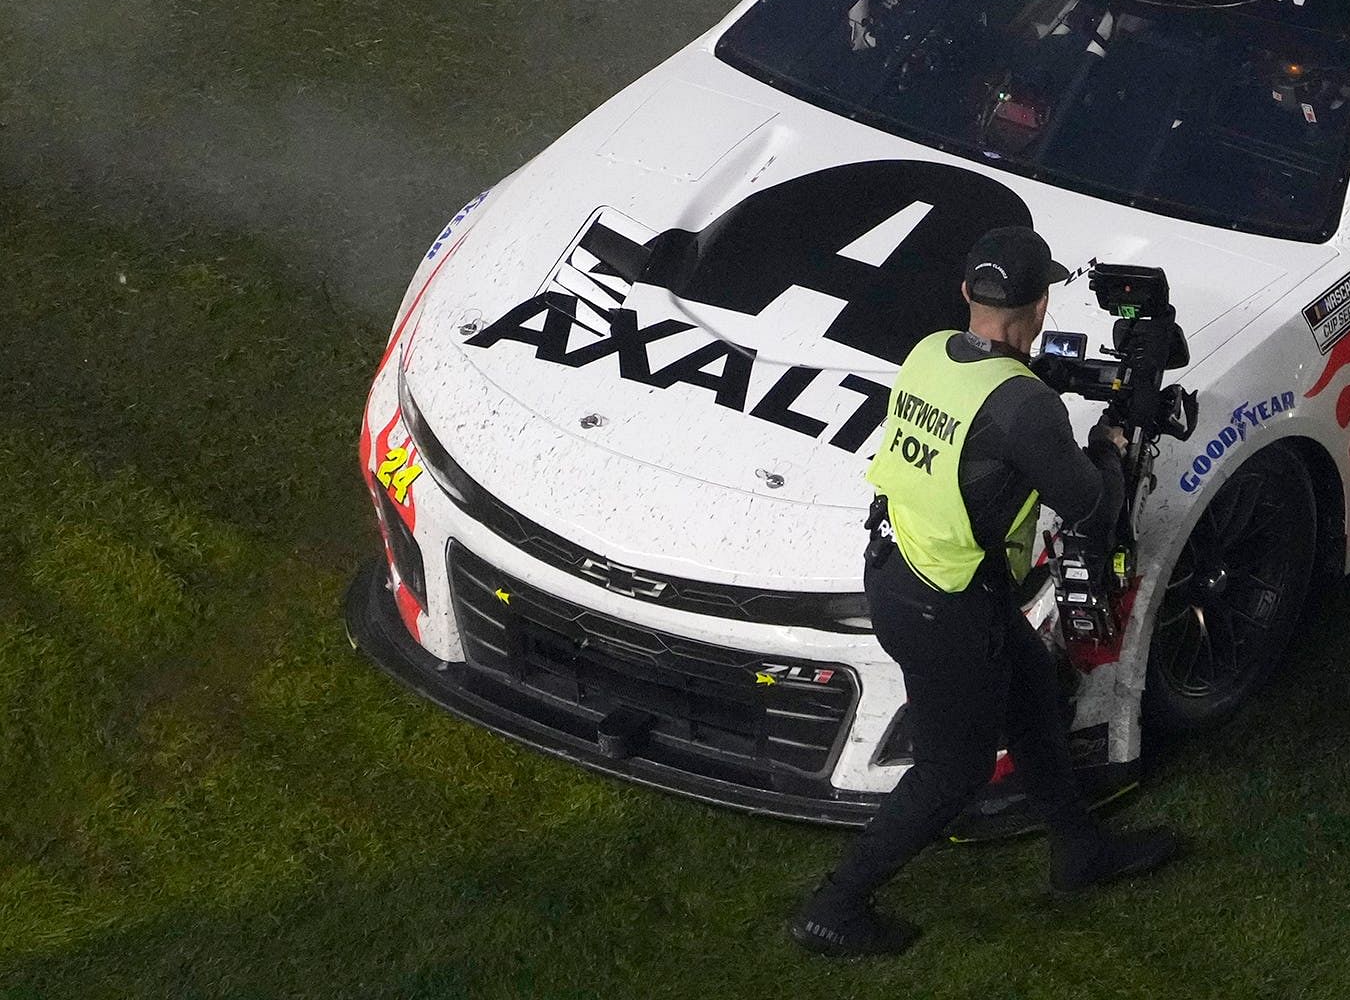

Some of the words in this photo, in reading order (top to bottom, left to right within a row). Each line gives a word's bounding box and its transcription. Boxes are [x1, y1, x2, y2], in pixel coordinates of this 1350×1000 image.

[1323, 316, 1338, 338] CUP
[463, 290, 892, 461] AXALT
[894, 390, 962, 445] NETWORK
[1180, 391, 1296, 493] GOODYEAR
[376, 447, 424, 505] 24
[890, 427, 940, 475] FOX
